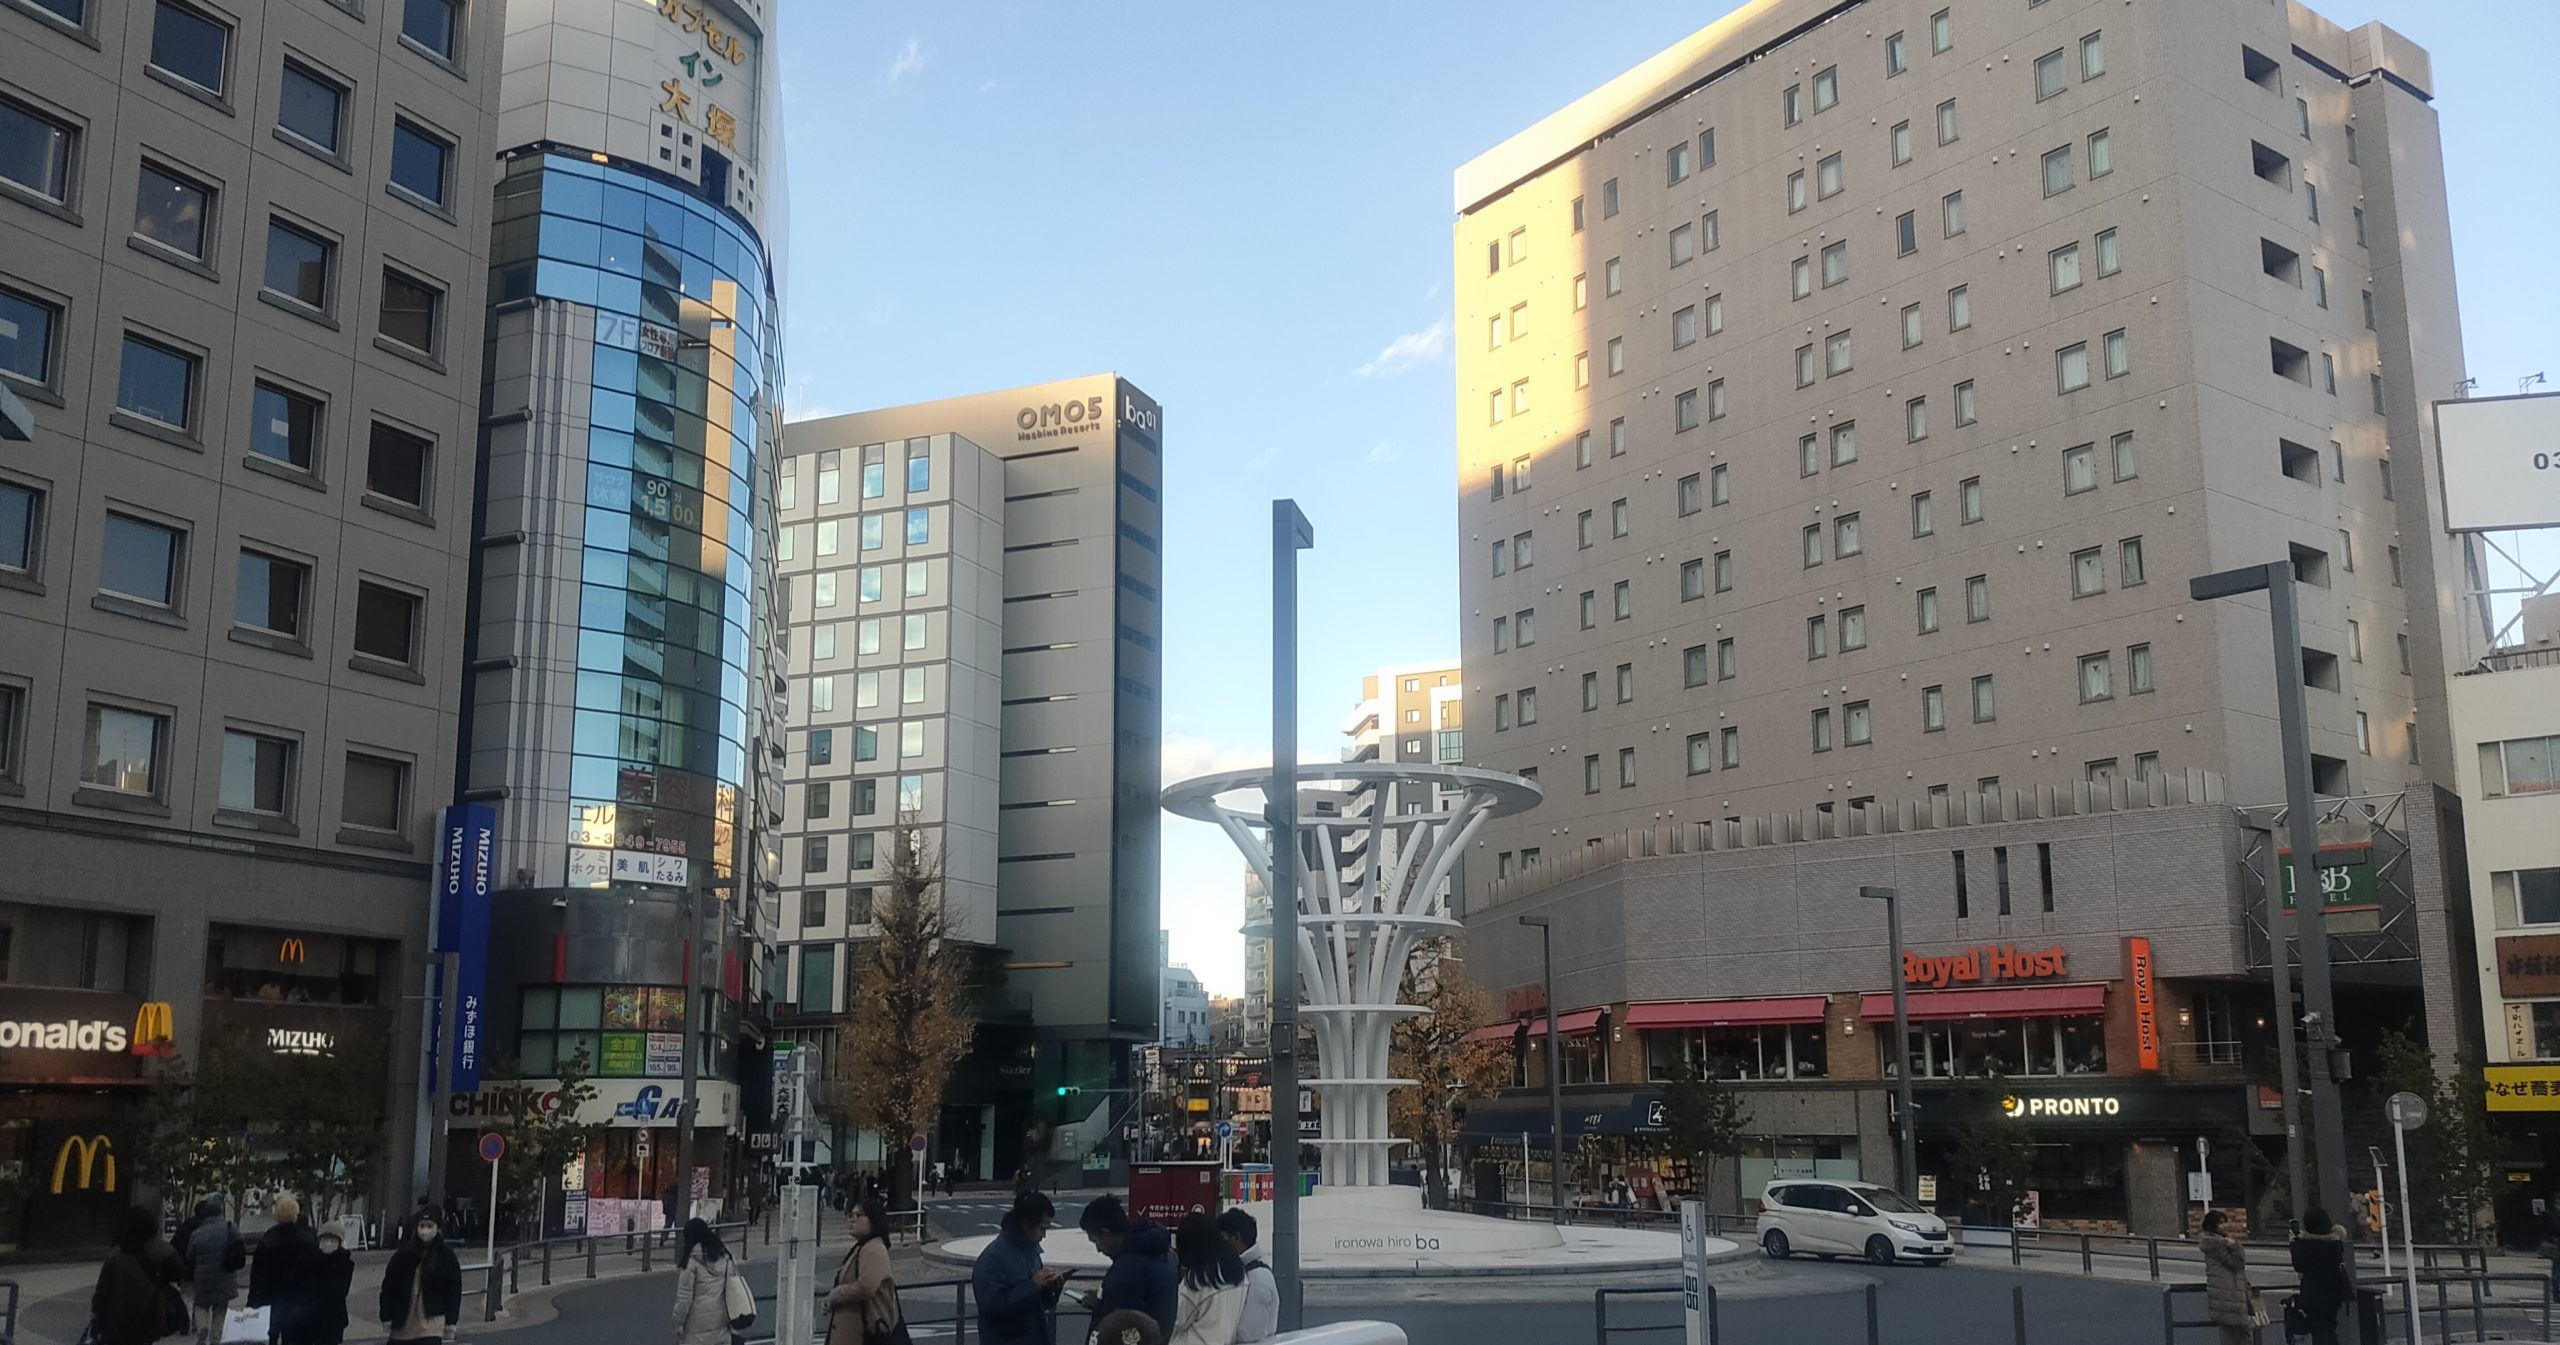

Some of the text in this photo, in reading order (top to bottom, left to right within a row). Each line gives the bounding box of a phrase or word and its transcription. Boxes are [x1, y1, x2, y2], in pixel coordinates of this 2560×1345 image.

[680, 51, 723, 88] イン
[660, 78, 737, 152] 大塚
[600, 314, 636, 346] 7F
[1017, 396, 1102, 430] OMO5
[1018, 422, 1101, 441] Hoshino Resorts
[449, 827, 463, 894] MIZUHO
[476, 828, 491, 896] MIZUHO
[616, 858, 650, 875] 美肌
[656, 869, 684, 883] たるみ
[1903, 944, 2068, 988] Royal Host
[2136, 955, 2152, 1051] Royal Host
[0, 1020, 127, 1052] onald's
[267, 1028, 335, 1050] MIZUHO
[462, 995, 478, 1070] みずほ銀行
[2029, 1097, 2119, 1116] PRONTO
[1334, 1233, 1440, 1250] ironowa hiro ba
